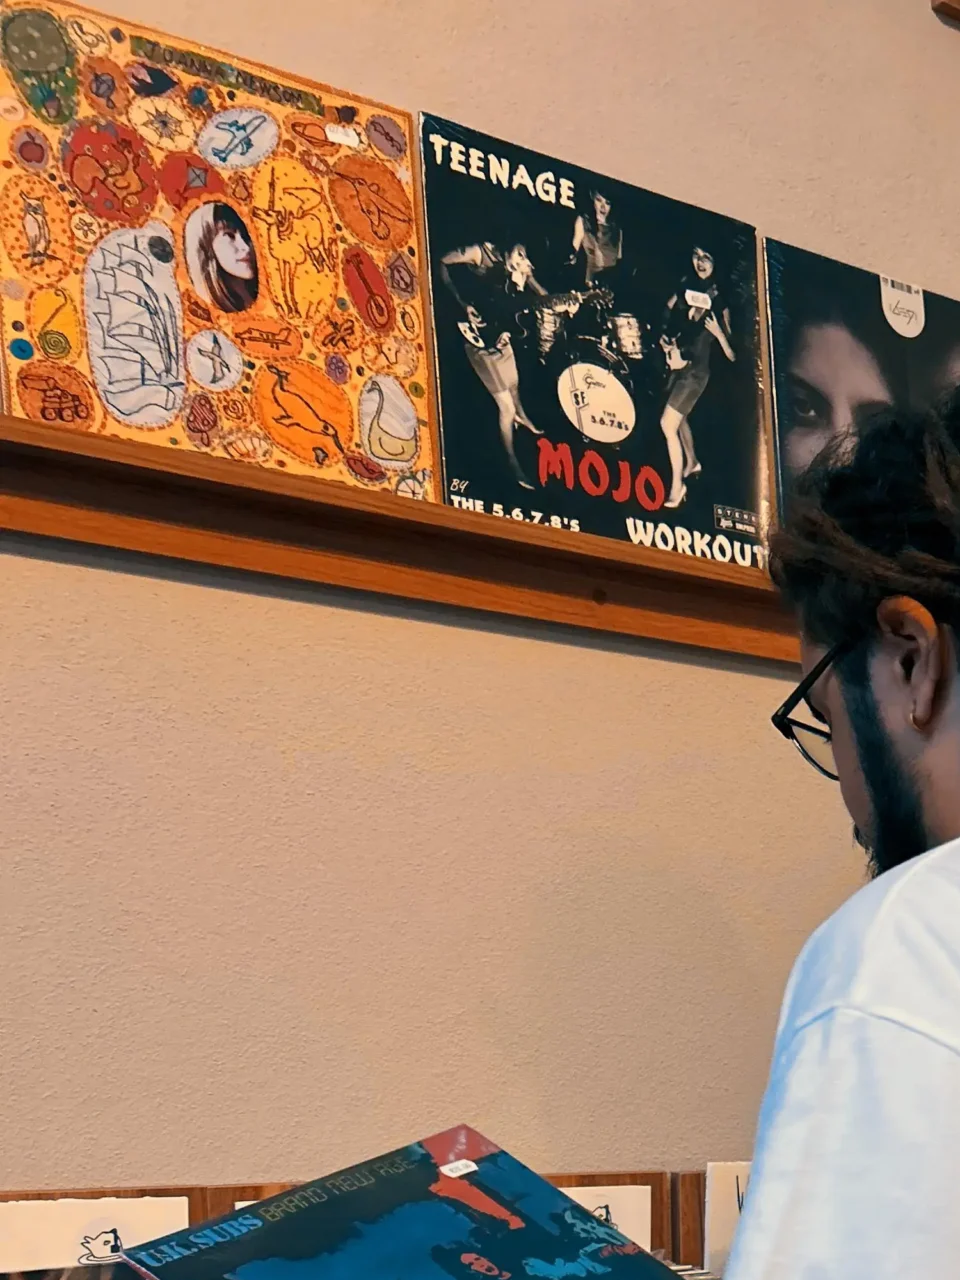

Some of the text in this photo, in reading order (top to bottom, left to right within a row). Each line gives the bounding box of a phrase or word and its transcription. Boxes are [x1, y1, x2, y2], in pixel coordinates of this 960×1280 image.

[429, 133, 576, 210] TEENAGE
[450, 478, 469, 493] BY
[537, 436, 665, 512] MOJO
[450, 494, 581, 533] THE 5.6.7.8'S
[625, 516, 770, 570] WORKOUT
[189, 1213, 264, 1249] SUBS
[258, 1186, 328, 1222] BRAND
[325, 1171, 376, 1194] NEW
[375, 1157, 416, 1177] AGE
